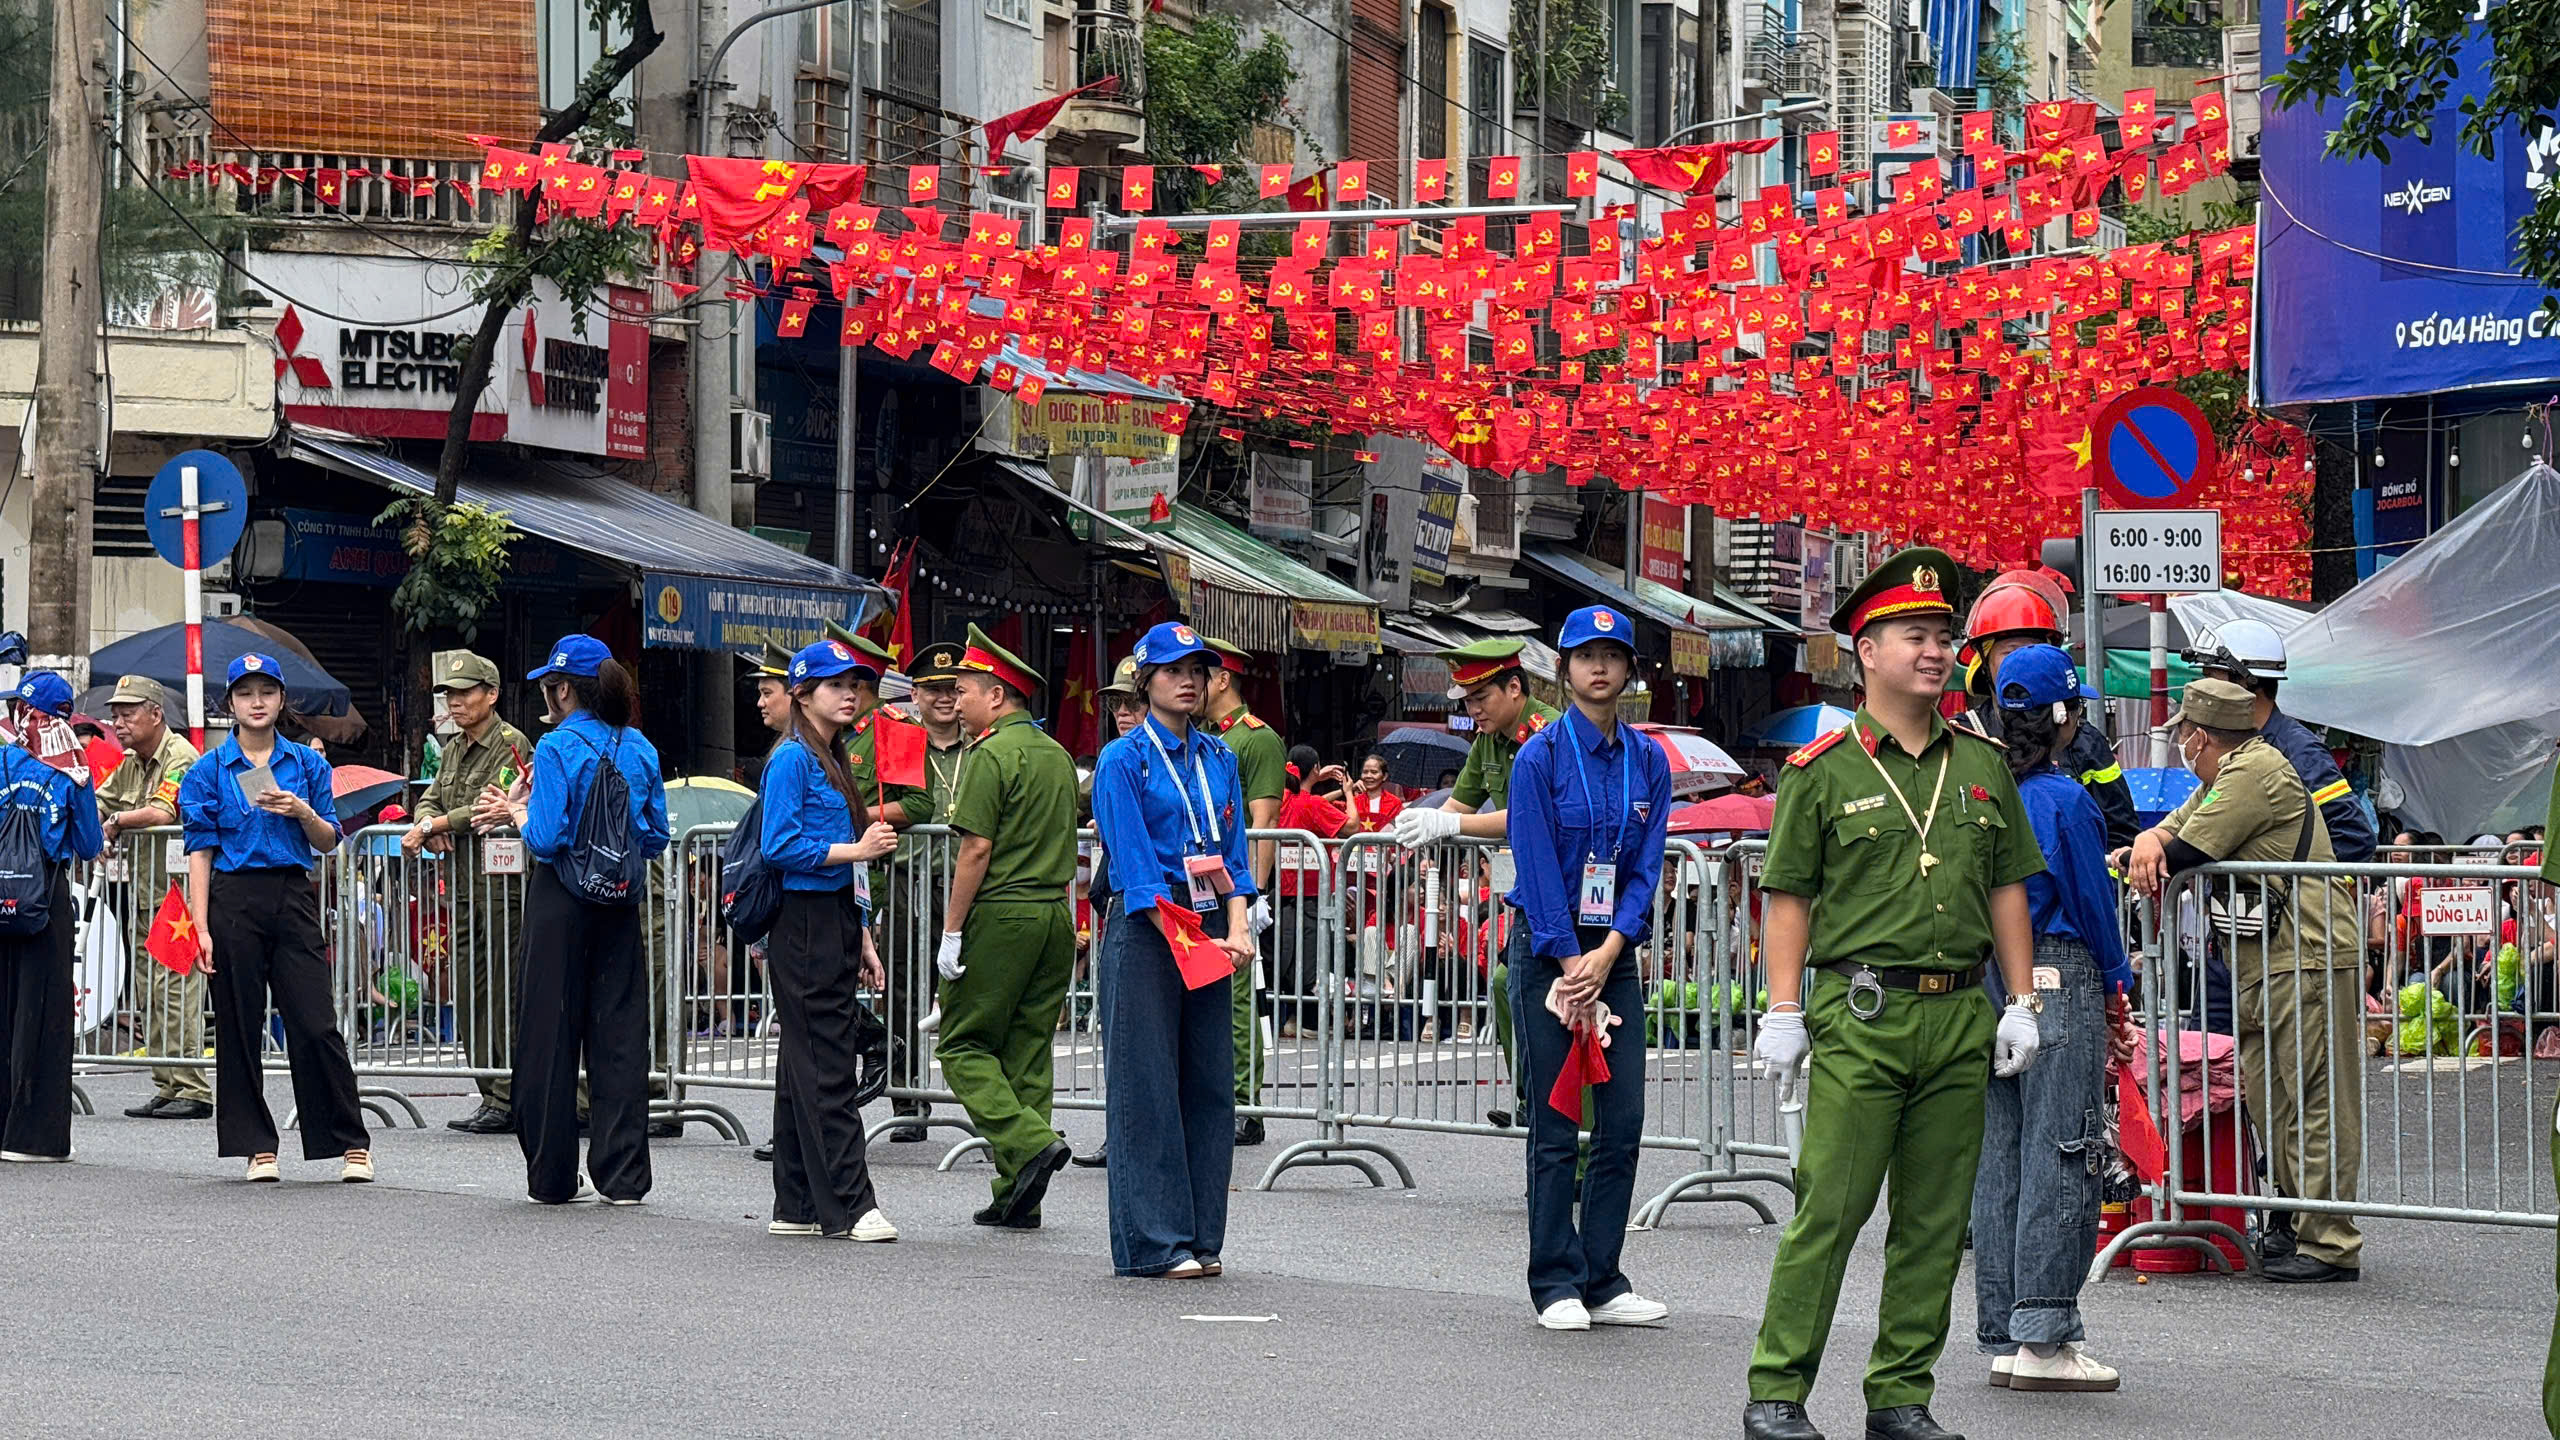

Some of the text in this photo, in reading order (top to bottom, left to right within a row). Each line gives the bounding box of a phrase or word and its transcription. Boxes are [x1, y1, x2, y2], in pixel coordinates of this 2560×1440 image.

[2409, 311, 2438, 348] Số
[2438, 316, 2466, 346] 04
[2468, 311, 2523, 346] Hàng
[340, 328, 472, 362] MITSUBI
[342, 361, 459, 393] ELECTRI
[325, 523, 336, 535] TY
[2110, 528, 2148, 547] 6:00
[2164, 528, 2202, 547] 9:00
[2103, 564, 2151, 583] 16:00
[664, 593, 678, 616] 119
[493, 855, 515, 866] STOP
[1194, 875, 1206, 892] N
[1591, 886, 1605, 904] N
[2440, 893, 2473, 903] C.A.H.N
[1583, 914, 1609, 924] PHỤC VỤ
[2426, 904, 2488, 926] DỪNG LẠI
